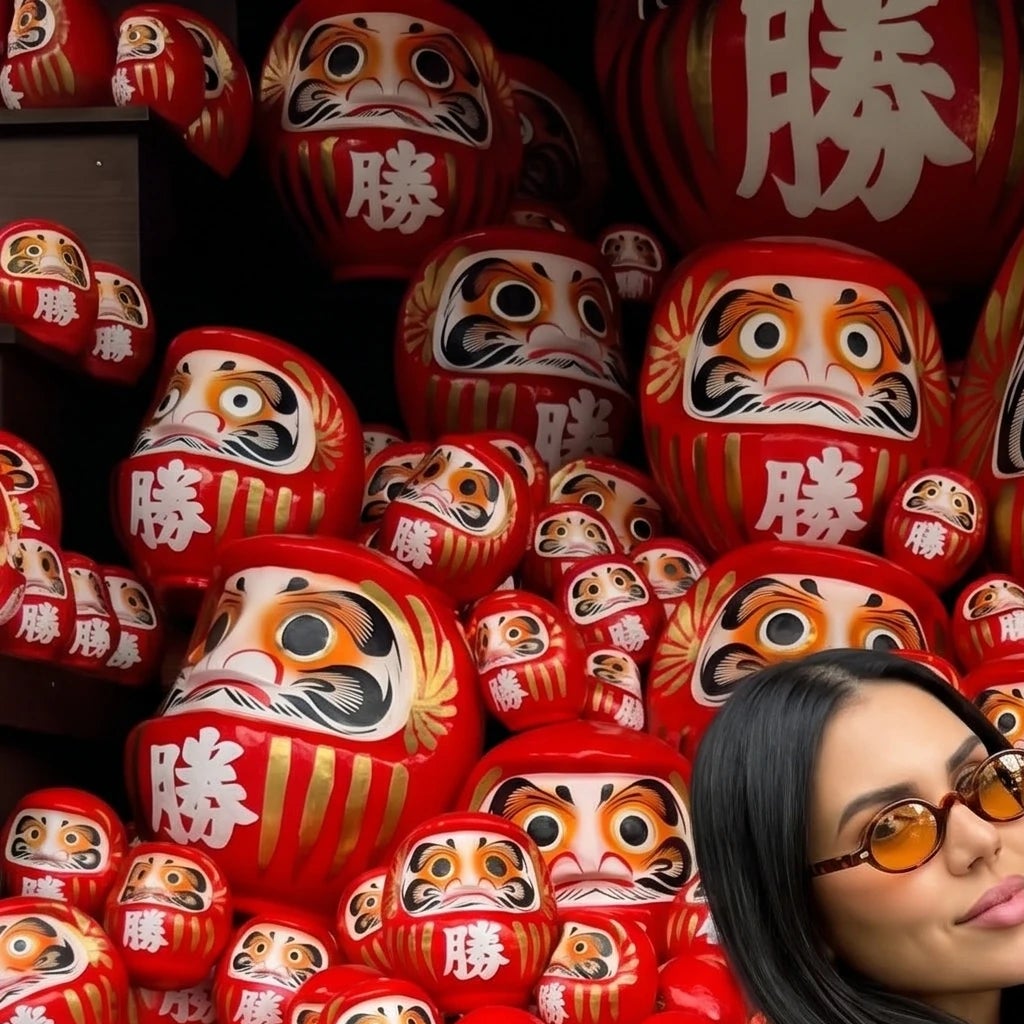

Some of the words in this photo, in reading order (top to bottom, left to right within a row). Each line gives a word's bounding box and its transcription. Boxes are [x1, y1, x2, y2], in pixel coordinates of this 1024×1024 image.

[736, 0, 973, 222] 勝
[346, 140, 444, 234] 勝
[33, 286, 79, 326] 勝
[131, 459, 210, 551] 勝
[755, 447, 867, 545] 勝
[391, 517, 438, 569] 勝
[16, 602, 61, 644] 勝
[69, 620, 110, 658] 勝
[151, 727, 259, 849] 勝
[123, 908, 169, 953] 勝
[443, 920, 509, 980] 勝
